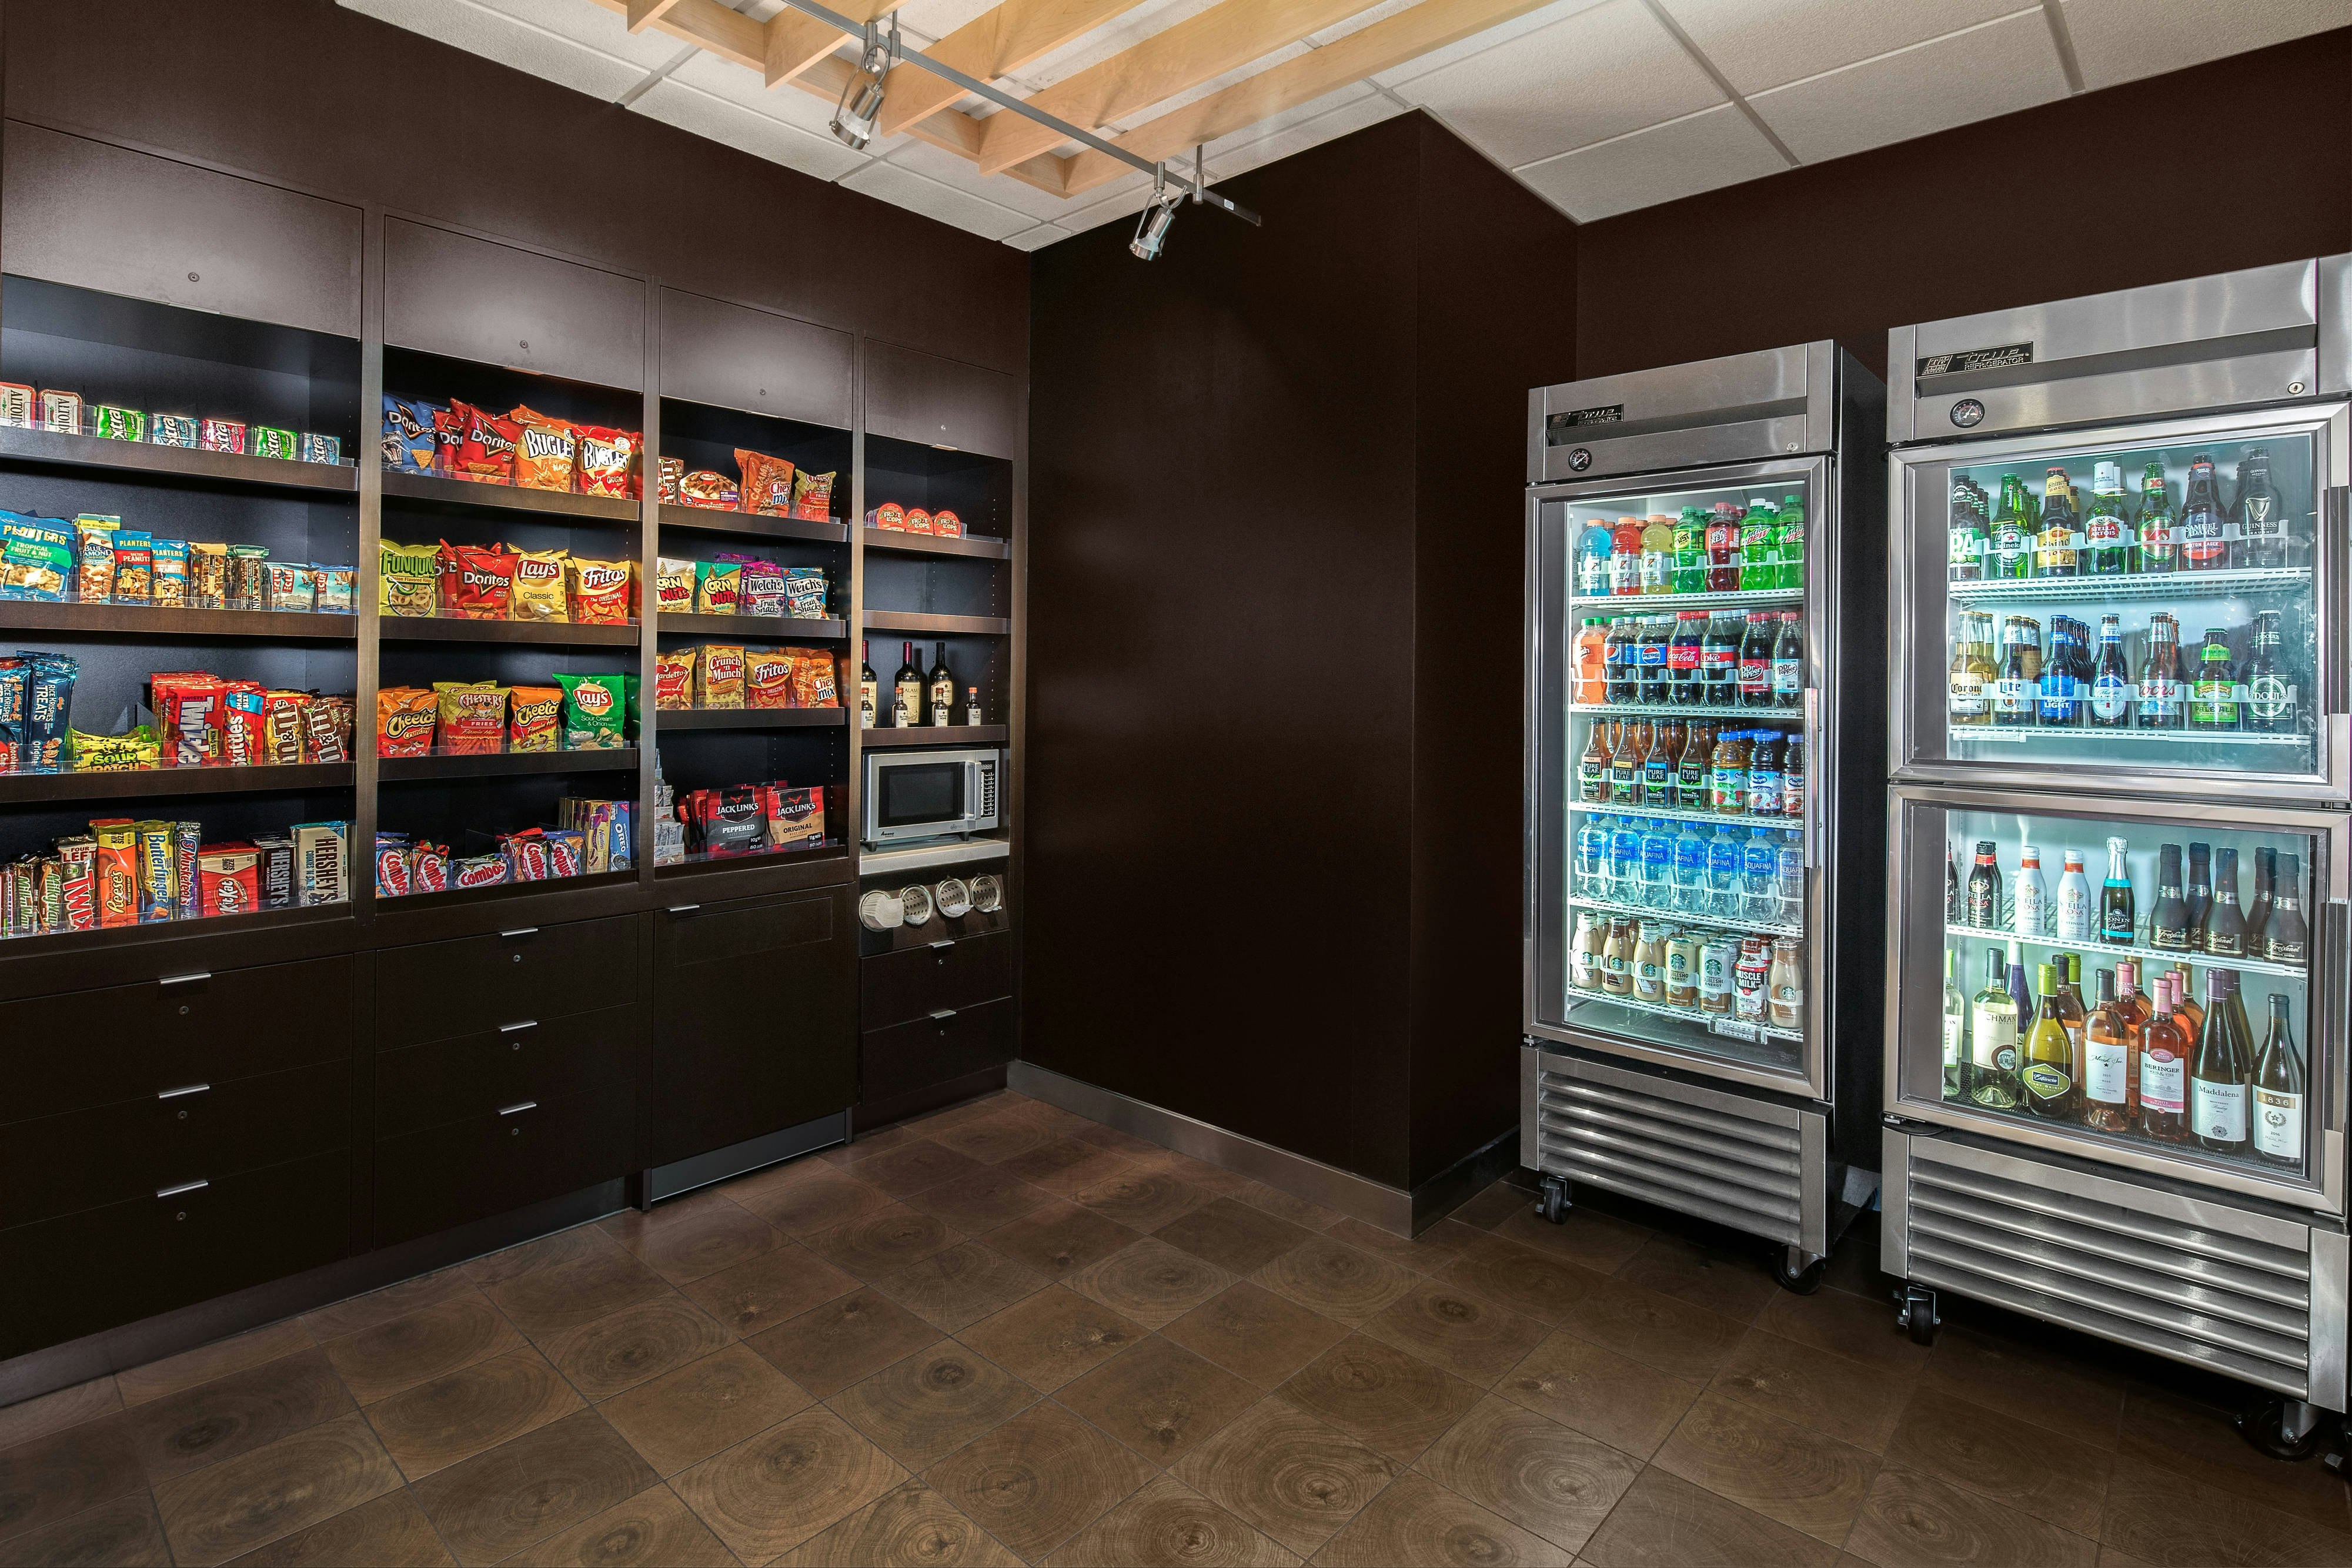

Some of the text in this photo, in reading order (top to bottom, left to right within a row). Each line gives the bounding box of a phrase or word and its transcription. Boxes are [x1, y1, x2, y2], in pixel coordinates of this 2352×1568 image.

[1964, 357, 2024, 370] REFRIGERATOR
[388, 411, 436, 434] Doritos
[1578, 416, 1618, 426] REFRIGERATOR
[524, 429, 576, 460] BUGLES
[770, 482, 791, 494] Chex
[886, 516, 903, 524] LOOPS
[2242, 521, 2277, 530] GUINNESS
[943, 523, 958, 531] LOOPS
[1712, 529, 1723, 537] BIG
[2185, 522, 2218, 533] SAMUEL
[2187, 528, 2216, 539] ADAMS
[3, 525, 67, 546] PLANTERS
[1711, 534, 1725, 544] RED
[11, 546, 32, 555] FRUIT
[16, 541, 48, 552] TROPICAL
[153, 549, 183, 557] PLANTERS
[519, 559, 558, 579] Lay's
[463, 571, 510, 587] Doritos
[582, 567, 626, 589] Fritos
[703, 576, 732, 594] CORN
[750, 579, 784, 591] Welch's
[787, 579, 823, 594] Welch's
[523, 591, 554, 600] Classic
[598, 591, 623, 602] ORIGINAL
[659, 586, 690, 601] NUTS
[710, 590, 737, 605] NUTS
[212, 595, 220, 609] KIN
[252, 596, 260, 610] KIN
[760, 600, 776, 608] Fruit
[800, 599, 816, 608] Fruit
[755, 606, 779, 614] Snacks
[797, 604, 822, 614] Snacks
[709, 655, 741, 670] Crunch
[1667, 650, 1696, 663] Coca-Cola
[1700, 653, 1720, 661] Coke
[712, 667, 742, 683] Munch
[754, 662, 789, 683] Fritos
[1740, 666, 1762, 677] Pepper
[1778, 666, 1797, 676] Pepper
[797, 660, 810, 701] CARAMEL
[813, 677, 834, 690] Chex
[1999, 681, 2021, 694] Lite
[34, 686, 48, 721] TREATS
[458, 693, 504, 710] CHESTER'S
[576, 690, 609, 707] Lay's
[1, 698, 11, 723] KRISPIES
[46, 700, 55, 724] KRISPIES
[386, 707, 437, 738] Cheetos
[403, 727, 432, 740] Crunchy
[31, 741, 42, 765] Original
[94, 753, 138, 764] SOUR
[716, 802, 759, 815] JACK LINK'S
[776, 802, 816, 817] JACK LINK'S
[722, 824, 755, 834] PEPPERED
[783, 823, 813, 834] ORIGINAL
[614, 823, 626, 852] OREO
[64, 852, 95, 862] LEFT
[306, 850, 315, 869] COOKIES
[147, 834, 169, 903] Butterfinger
[179, 839, 195, 906] 3 Musketeers
[315, 837, 339, 904] HERSHEY'S
[1745, 861, 1773, 871] AQUAFINA
[270, 851, 290, 909] HERSHEY'S
[385, 854, 409, 895] Combos
[424, 857, 446, 891] Combo
[460, 864, 506, 886] Combos
[106, 870, 124, 914] Reese's
[2266, 941, 2301, 953] Freixenet
[1737, 971, 1761, 981] MUSCLE
[1738, 980, 1756, 988] MILK
[2144, 1062, 2180, 1073] BERINGER
[2199, 1085, 2239, 1098] Maddalena
[2261, 1094, 2289, 1106] 1836
